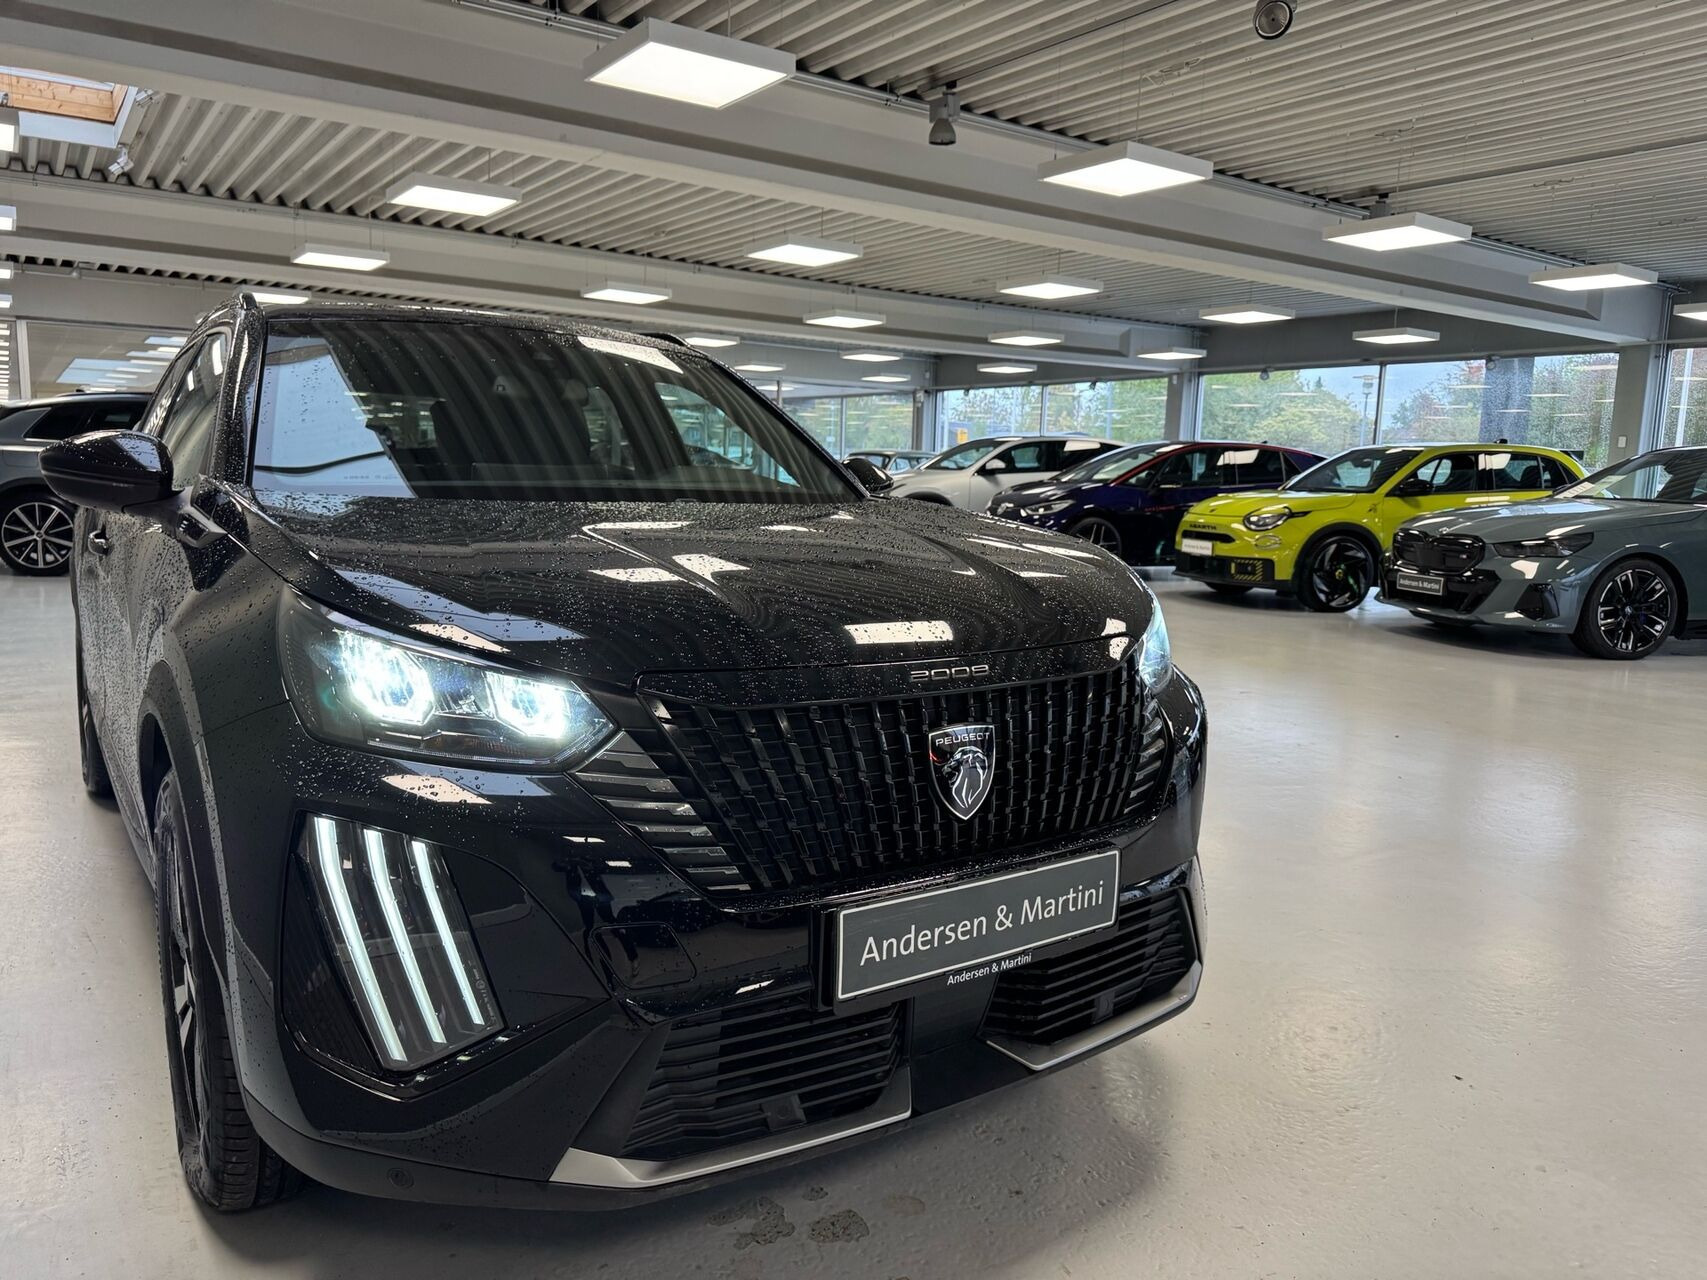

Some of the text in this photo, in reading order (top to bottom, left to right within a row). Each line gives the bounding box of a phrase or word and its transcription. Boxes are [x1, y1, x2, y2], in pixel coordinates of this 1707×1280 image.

[910, 664, 989, 681] 2008
[935, 732, 990, 747] PEUGEOT
[859, 879, 1104, 967] Andersen & Martini
[946, 952, 1032, 986] Andersen & Martini
